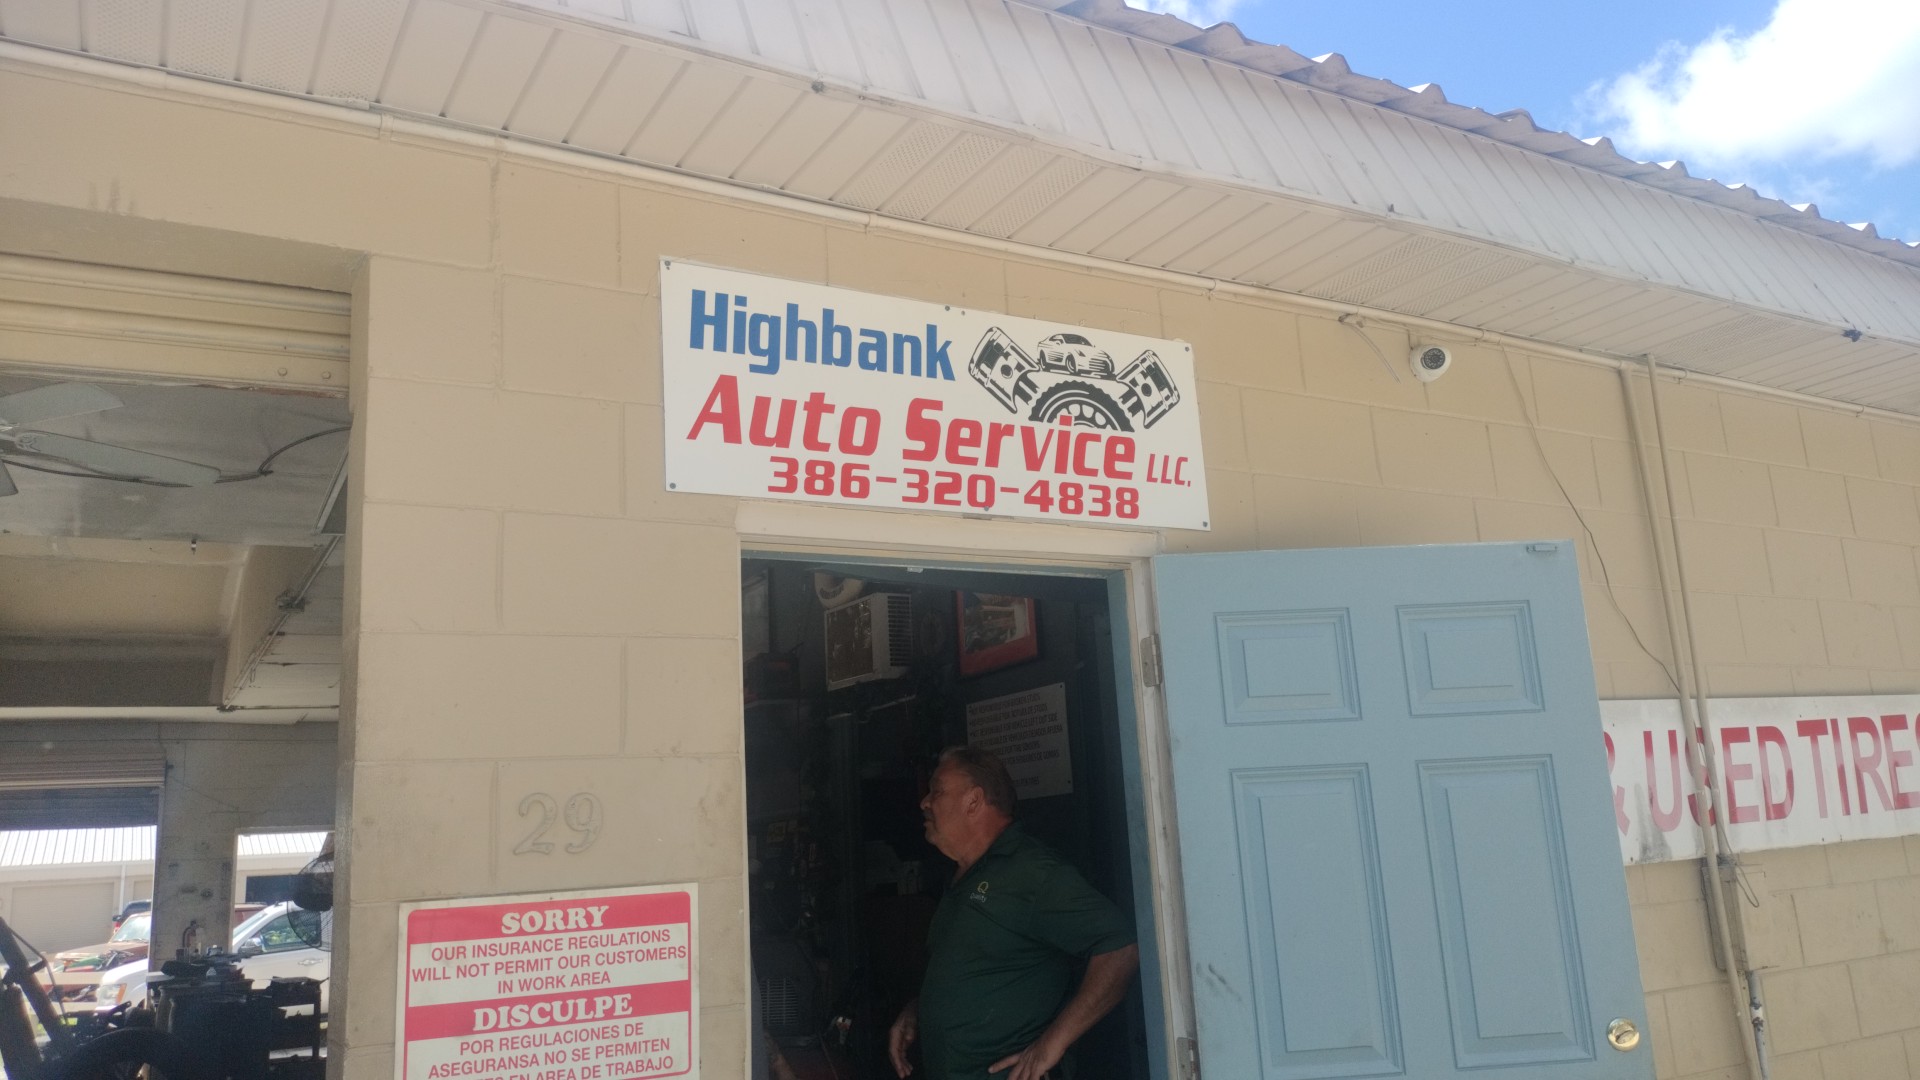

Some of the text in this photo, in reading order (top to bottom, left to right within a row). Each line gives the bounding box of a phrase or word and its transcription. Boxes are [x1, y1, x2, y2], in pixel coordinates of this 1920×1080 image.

[689, 288, 956, 381] Highbank
[686, 374, 881, 456] Auto
[902, 397, 1136, 480] Service
[768, 456, 1140, 520] 386-320-4838
[1796, 713, 1920, 819] TIRE
[513, 792, 603, 856] 29
[501, 905, 609, 934] SORRY
[412, 945, 687, 982] WILL NOT PERMIT OUR CUSTOMERS
[431, 929, 671, 961] OUR INSURANCE REGULATIONS
[498, 971, 611, 994] IN WORK AREA
[472, 993, 633, 1032] DISCULPE
[428, 1037, 670, 1079] ASEGURANSA NO SE PERMITEN
[460, 1022, 644, 1056] POR REGULACIONES DE
[536, 1068, 577, 1080] AREA
[581, 1065, 601, 1080] DE
[605, 1056, 674, 1077] TRABAJO
